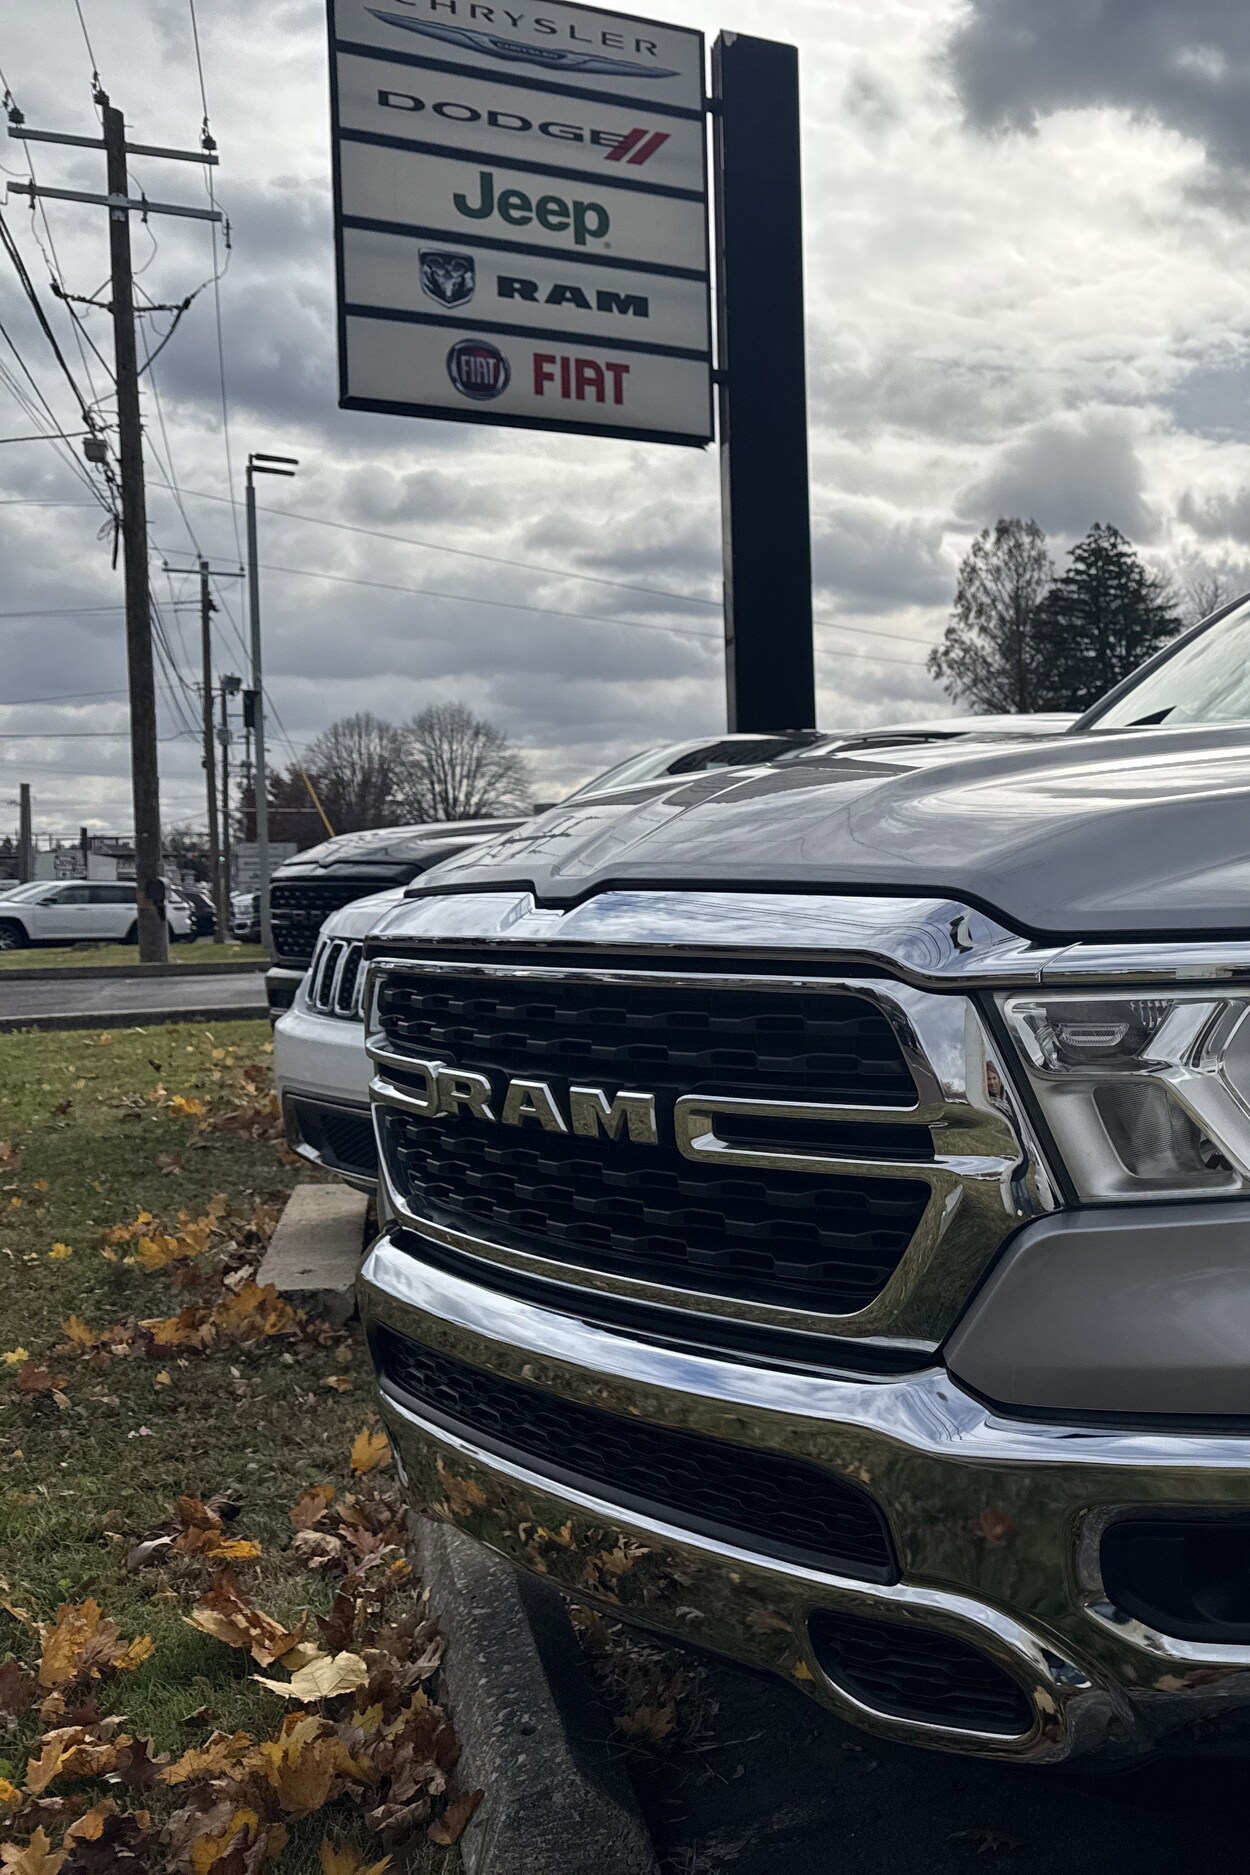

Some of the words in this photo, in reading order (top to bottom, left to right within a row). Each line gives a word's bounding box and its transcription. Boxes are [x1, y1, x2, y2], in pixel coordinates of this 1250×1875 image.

[395, 0, 658, 56] HRYSLER
[377, 89, 631, 149] DODGE
[453, 170, 611, 246] Jeep
[497, 275, 649, 318] RAM
[460, 355, 497, 386] FIAT
[533, 353, 630, 405] FIAT
[436, 1066, 659, 1146] RAM
